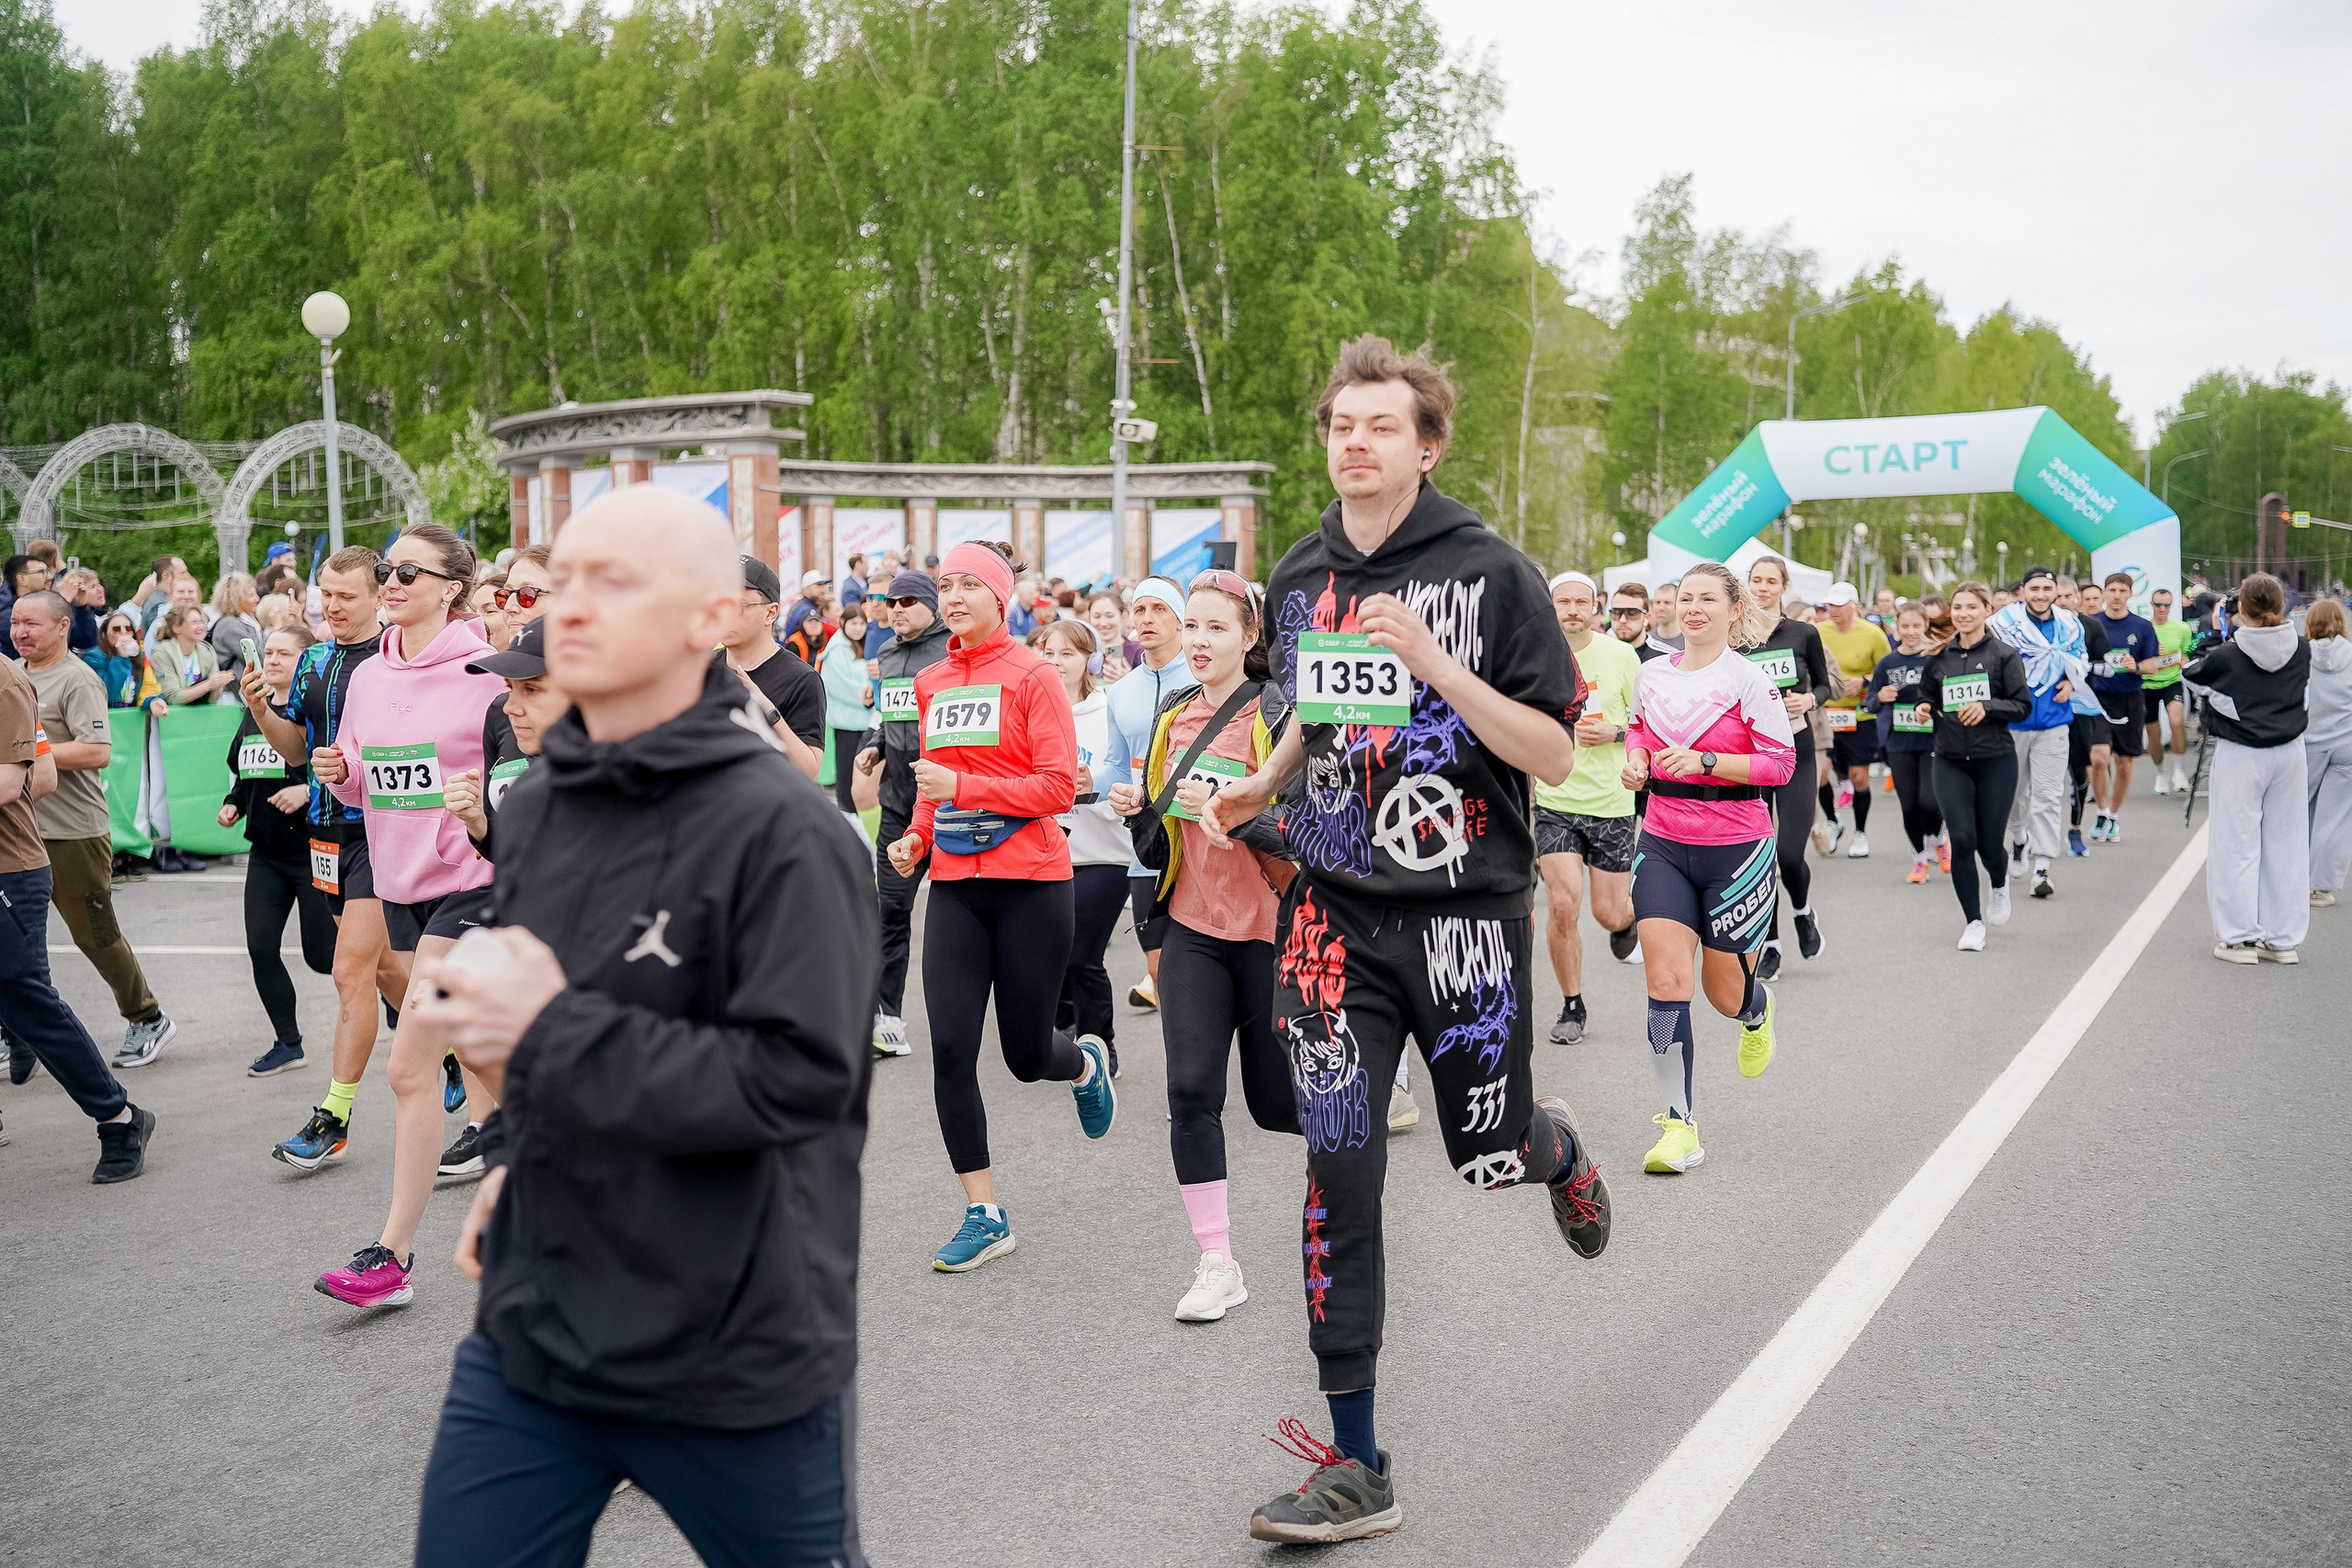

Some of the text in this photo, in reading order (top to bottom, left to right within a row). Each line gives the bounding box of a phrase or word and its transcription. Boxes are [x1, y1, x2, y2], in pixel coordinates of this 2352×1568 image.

[1824, 440, 1969, 476] СТАРТ
[1690, 469, 1749, 529] зелёный
[2038, 468, 2103, 525] марафон
[2048, 457, 2118, 513] зелёный
[1700, 481, 1758, 539] марафон
[1310, 660, 1397, 695] 1353
[1949, 685, 1984, 700] 1314
[935, 703, 991, 730] 1579
[243, 748, 277, 765] 1165
[371, 764, 432, 790] 1373
[316, 855, 331, 877] 155
[1461, 1074, 1509, 1134] 333
